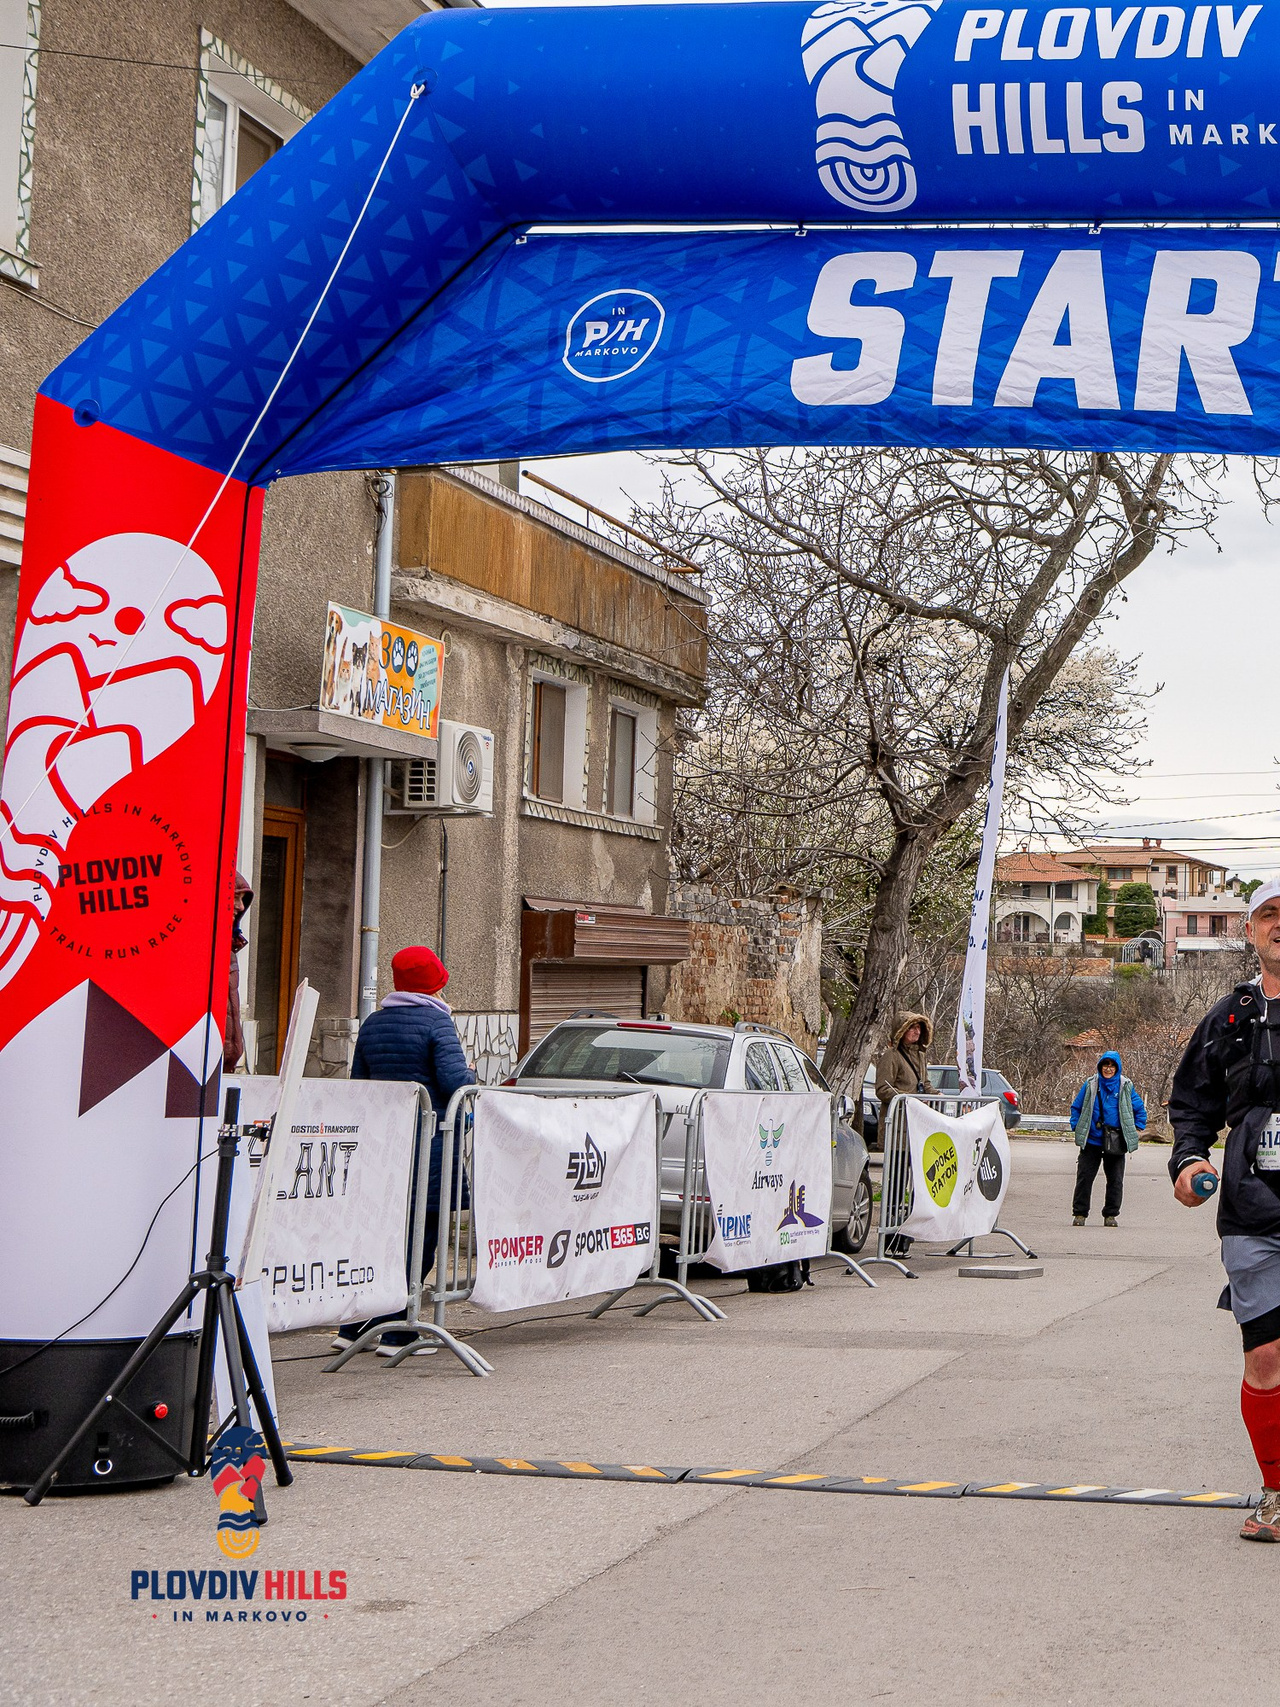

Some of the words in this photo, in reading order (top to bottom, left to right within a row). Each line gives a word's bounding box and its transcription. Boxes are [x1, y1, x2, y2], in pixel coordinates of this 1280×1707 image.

[953, 4, 1263, 62] PLOVDIV
[952, 80, 1146, 155] HILLS
[1168, 89, 1205, 112] IN
[611, 307, 626, 316] IN
[574, 346, 639, 357] MARKOVO
[363, 678, 431, 730] МАГАЗИН
[33, 829, 59, 902] PLOVDIV
[62, 802, 113, 829] HILLS
[124, 804, 142, 817] IN
[150, 814, 192, 885] MARKOVO
[57, 853, 163, 888] PLOVDIV
[78, 885, 150, 915] HILLS
[49, 926, 93, 959] TRAIL
[104, 945, 140, 960] RUN
[148, 914, 182, 948] RACE
[934, 1147, 955, 1172] POKE
[752, 1171, 784, 1192] Airways
[931, 1161, 958, 1198] STATON
[488, 1235, 544, 1270] SPONSER
